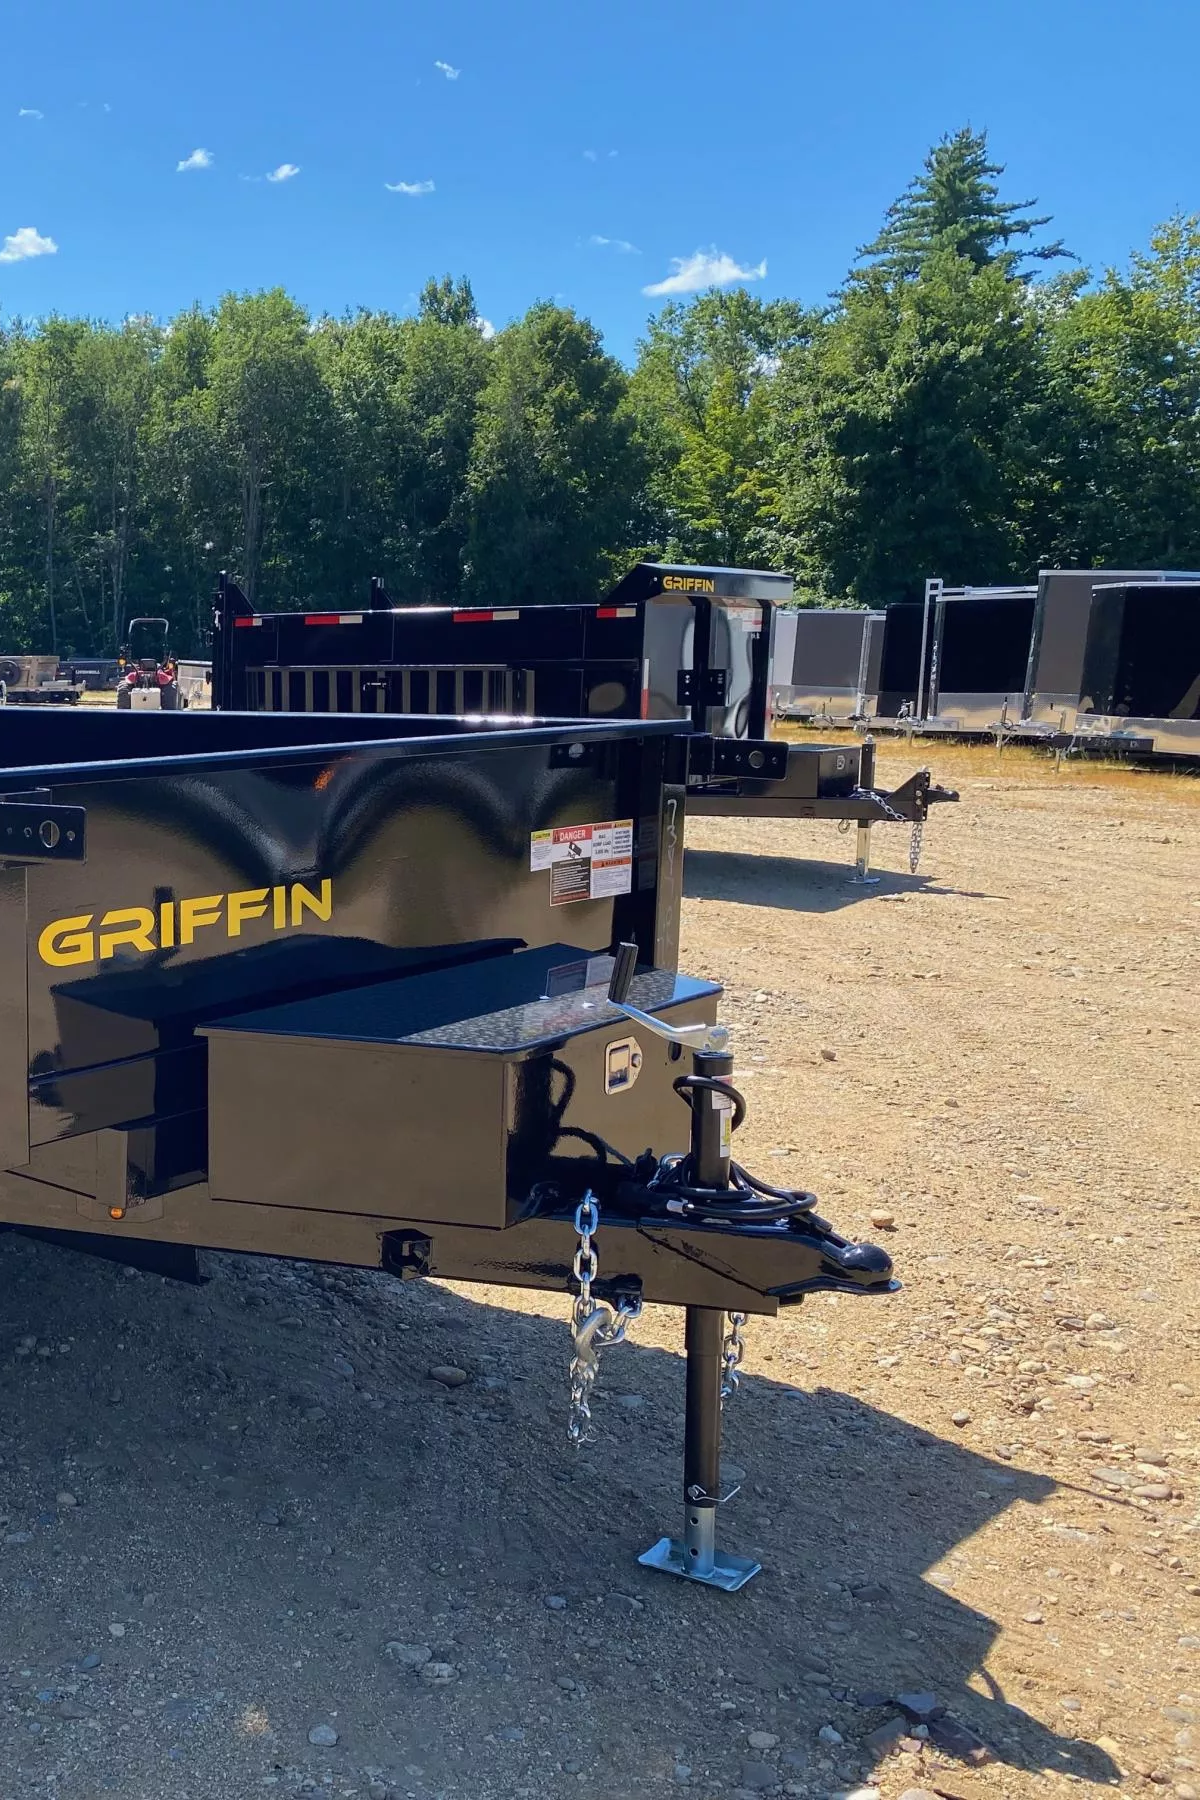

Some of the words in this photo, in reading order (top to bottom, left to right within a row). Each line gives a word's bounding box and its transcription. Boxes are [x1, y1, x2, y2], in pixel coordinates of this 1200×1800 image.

[663, 576, 714, 592] GRIFFIN
[560, 830, 586, 841] DANGER
[38, 879, 333, 967] GRIFFIN
